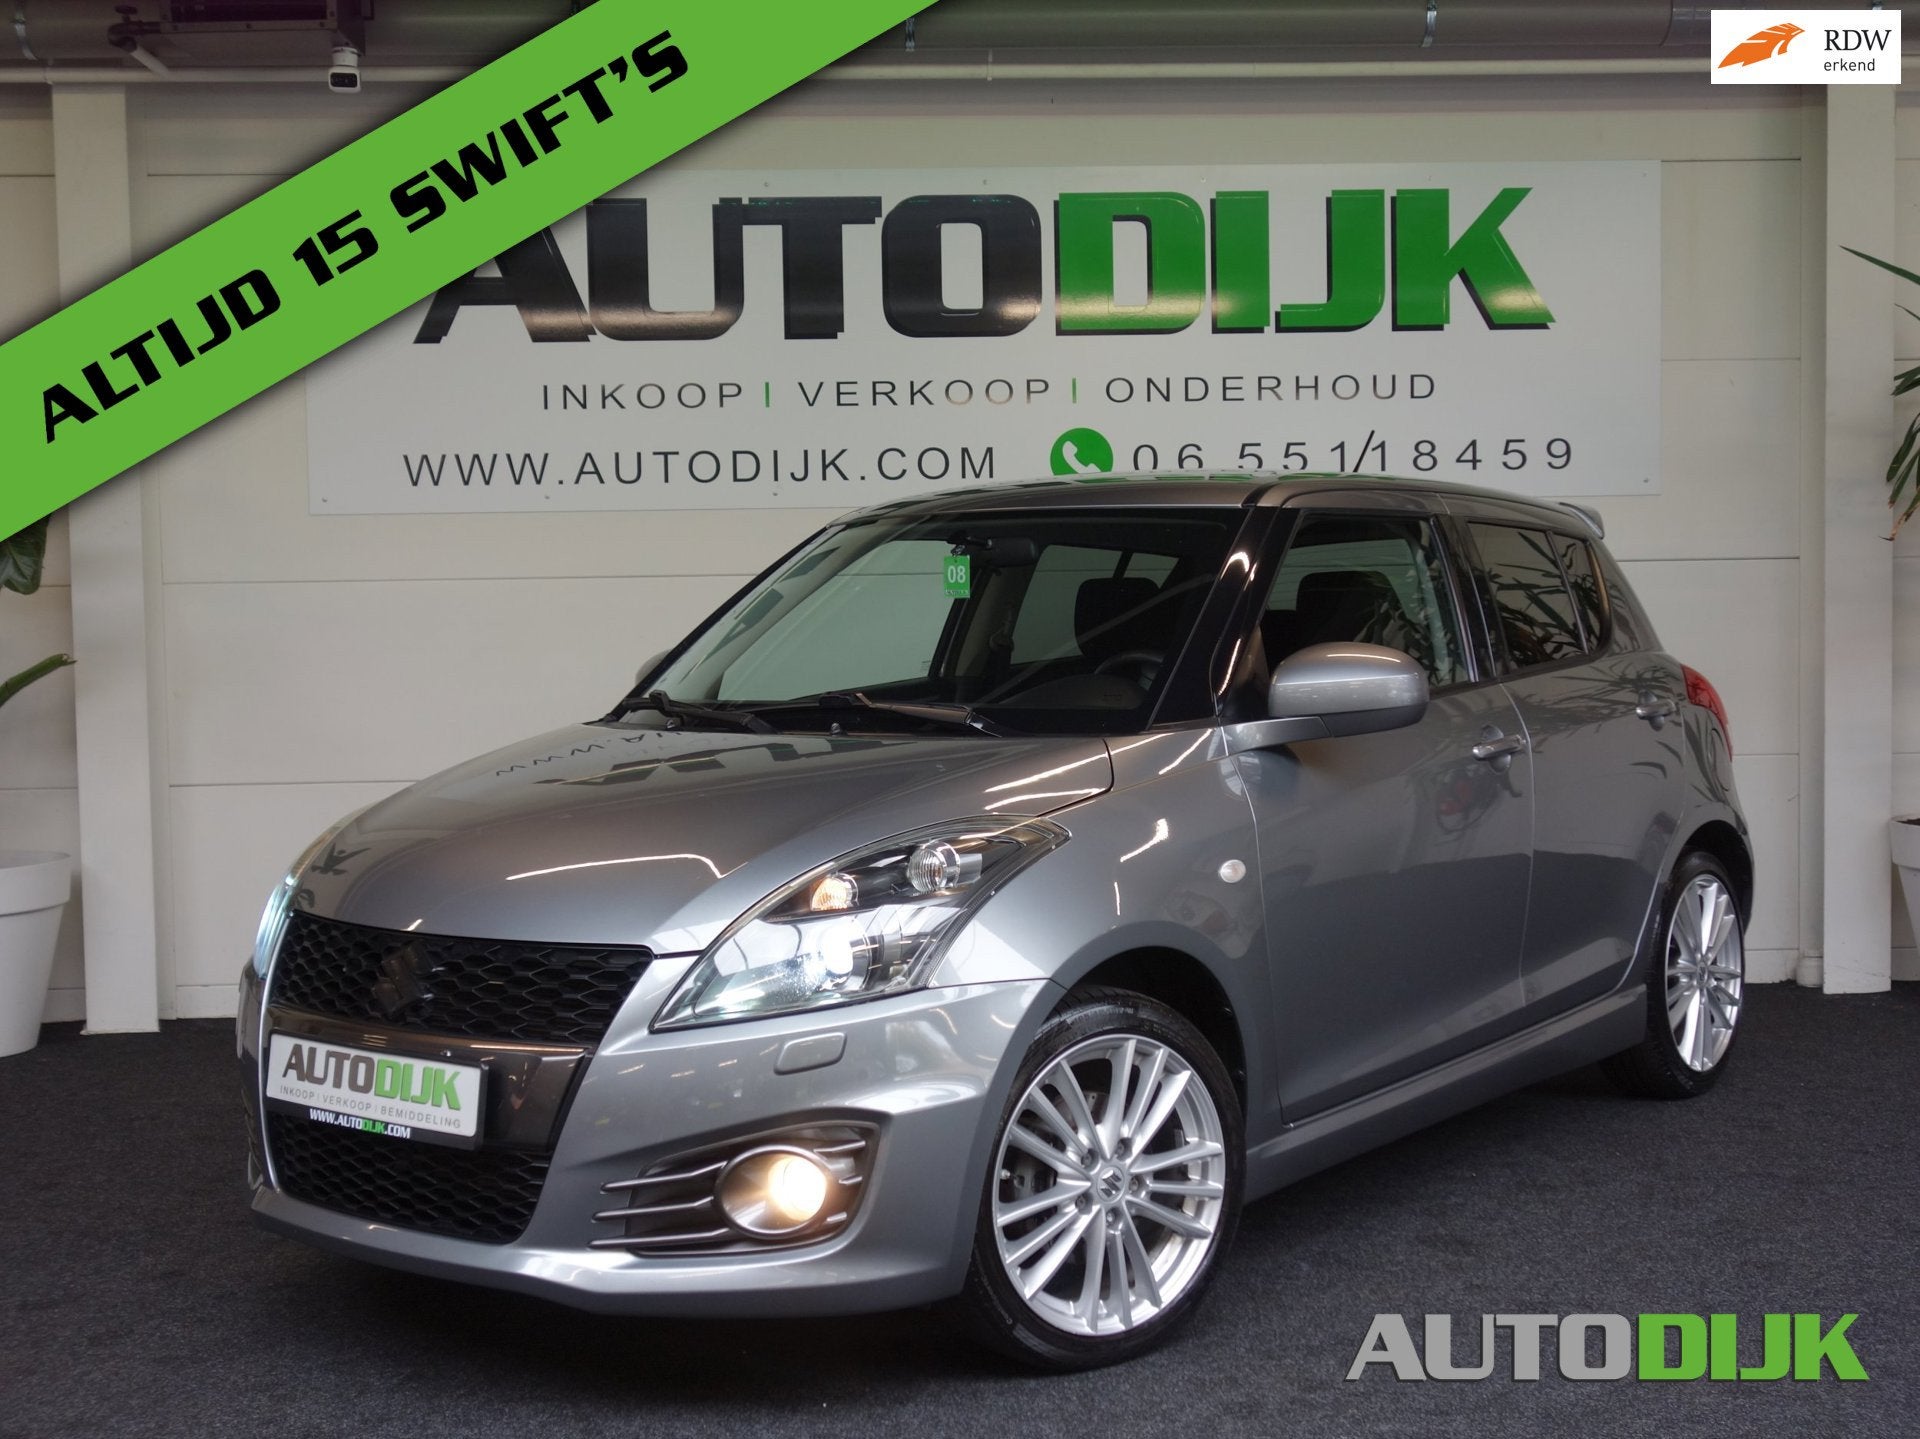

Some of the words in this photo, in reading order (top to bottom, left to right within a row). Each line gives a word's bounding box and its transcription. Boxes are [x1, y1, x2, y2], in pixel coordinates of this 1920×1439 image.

[412, 186, 1557, 344] AUTODIJK
[542, 382, 744, 411] INKOOP
[797, 378, 1051, 408] VERKOOP
[1104, 373, 1436, 404] ONDERHOUD
[402, 446, 995, 487] WWW.AUTODIJK.COM
[947, 565, 966, 583] 08
[282, 1043, 462, 1111] AUTODIJK
[280, 1084, 316, 1100] INKOOP
[322, 1094, 372, 1112] VERKOOP
[380, 1105, 462, 1129] BEMIDDELING
[309, 1107, 411, 1139] WWW.AUTODIJK.COM
